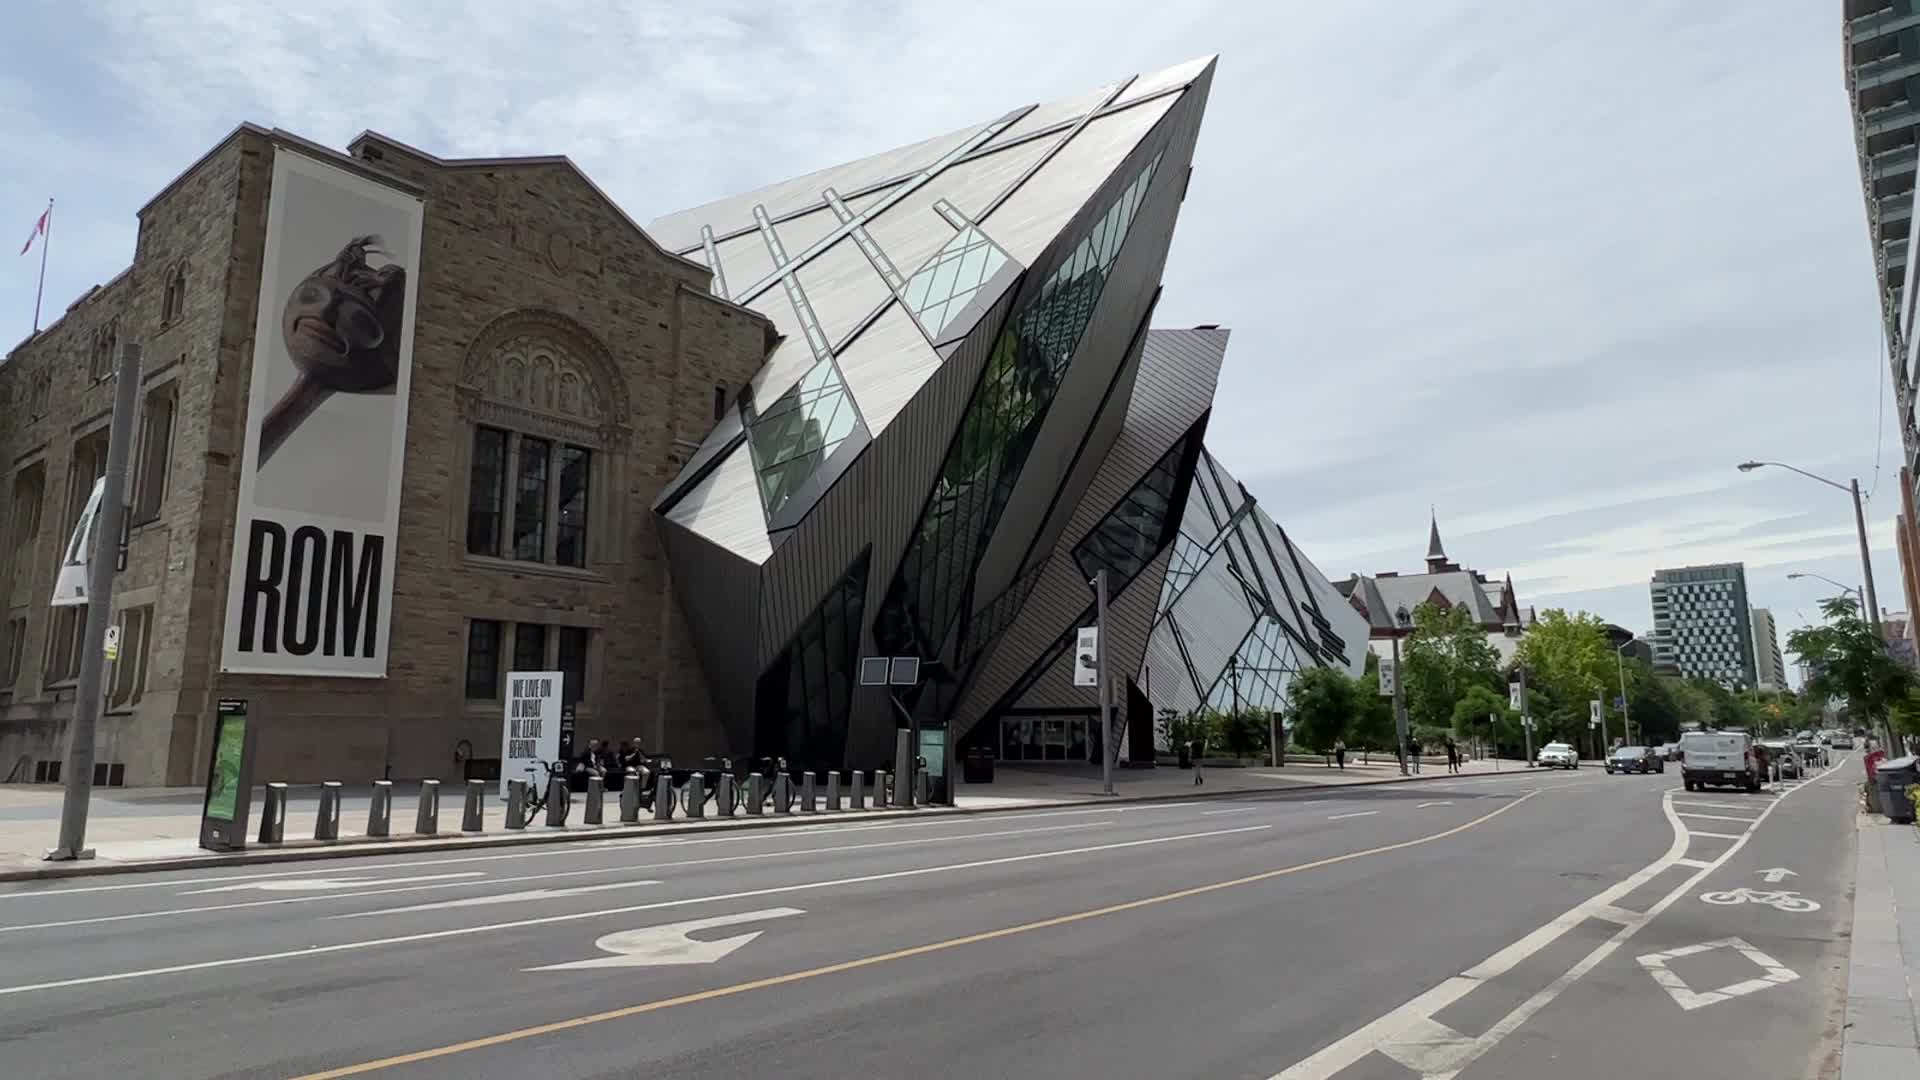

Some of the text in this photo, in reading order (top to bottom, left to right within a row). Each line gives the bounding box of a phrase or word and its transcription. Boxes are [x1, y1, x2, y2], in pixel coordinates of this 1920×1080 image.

[238, 519, 384, 658] ROM
[513, 679, 552, 697] WE LIVE ON
[512, 699, 521, 717] IN
[521, 699, 542, 717] WHAT
[510, 719, 521, 738] WE
[522, 719, 543, 738] LEAVE
[509, 740, 537, 758] BEHIND.
